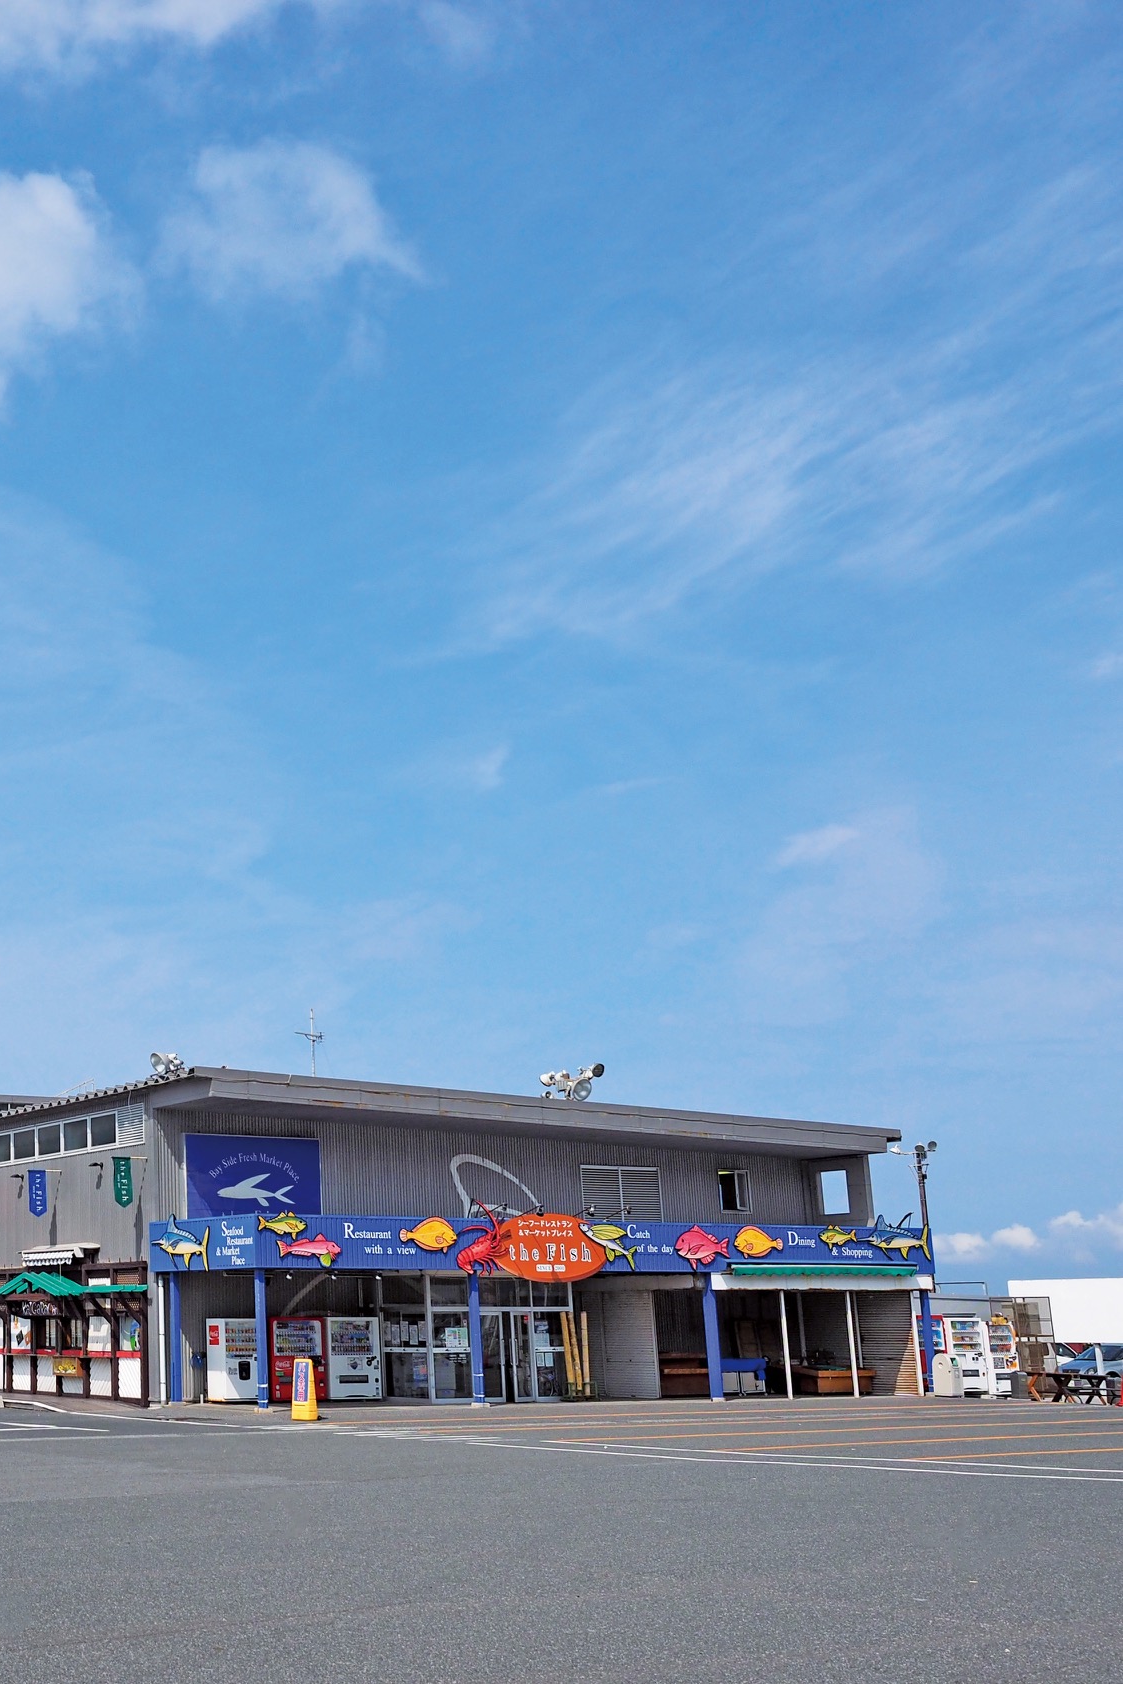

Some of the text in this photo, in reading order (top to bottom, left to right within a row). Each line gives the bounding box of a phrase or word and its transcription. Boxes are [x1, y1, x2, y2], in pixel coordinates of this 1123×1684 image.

[209, 1165, 223, 1178] Bay
[221, 1156, 237, 1168] Side
[238, 1152, 257, 1163] Fresh
[259, 1152, 283, 1168] Market
[221, 1221, 244, 1236] Seafood
[343, 1223, 392, 1239] Restaurant
[626, 1224, 650, 1239] Catch
[227, 1237, 253, 1246] Restaurant
[787, 1231, 816, 1247] Dining
[215, 1245, 240, 1256] & Market
[364, 1245, 383, 1255] with
[396, 1245, 417, 1255] view
[509, 1241, 592, 1262] the Fish
[636, 1243, 673, 1255] of the day
[831, 1247, 873, 1259] & Shopping
[231, 1256, 245, 1265] Place
